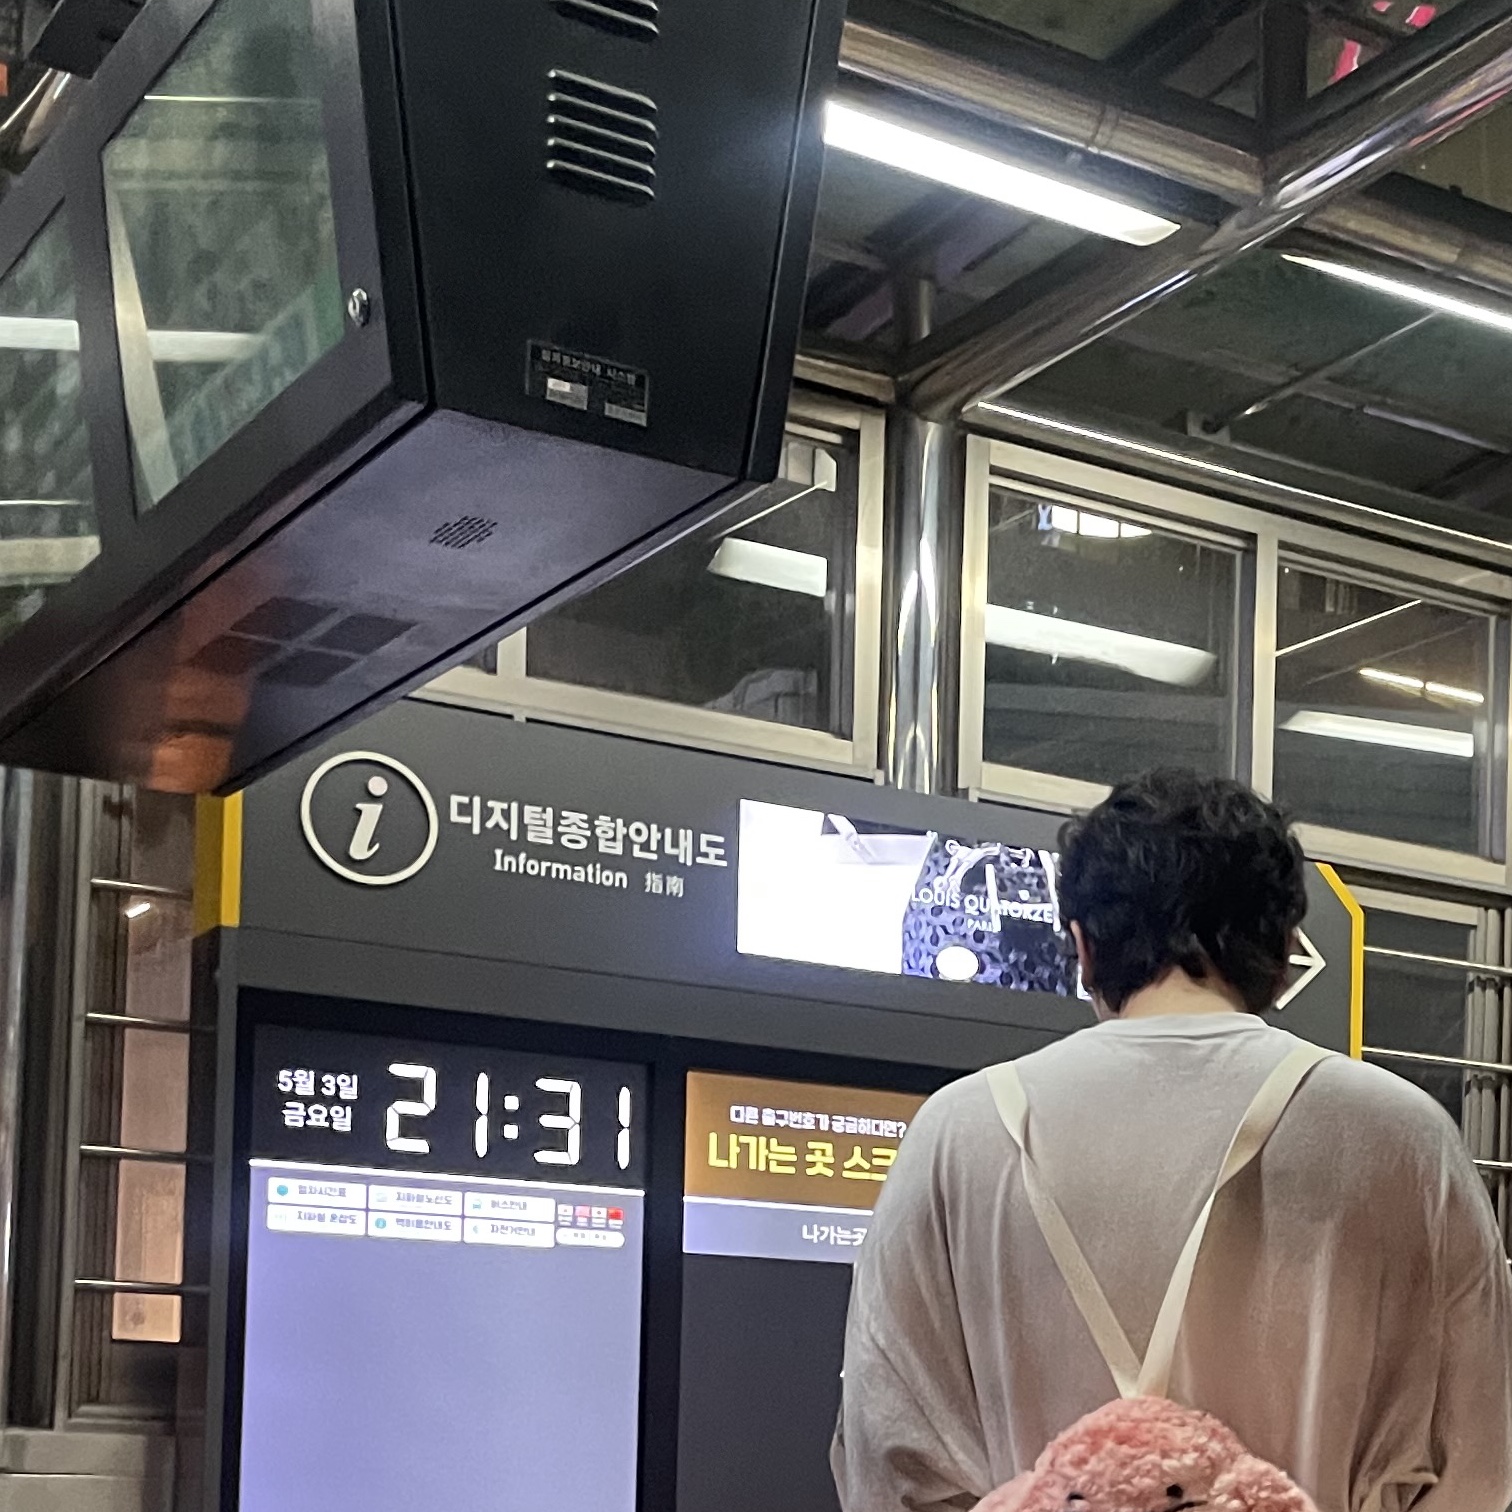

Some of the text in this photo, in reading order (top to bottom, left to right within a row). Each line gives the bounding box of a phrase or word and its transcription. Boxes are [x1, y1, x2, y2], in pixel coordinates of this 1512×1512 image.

[449, 794, 728, 867] 디지털종합안내도
[494, 849, 685, 898] Information 指南
[912, 887, 961, 910] LOUIS
[278, 1069, 358, 1100] 5월 3일
[282, 1101, 352, 1132] 금요일
[386, 1062, 631, 1170] 21:31
[729, 1105, 907, 1138] 다른 출구번호가 궁금하다면?
[708, 1132, 797, 1175] 나가는
[806, 1141, 835, 1178] 곳
